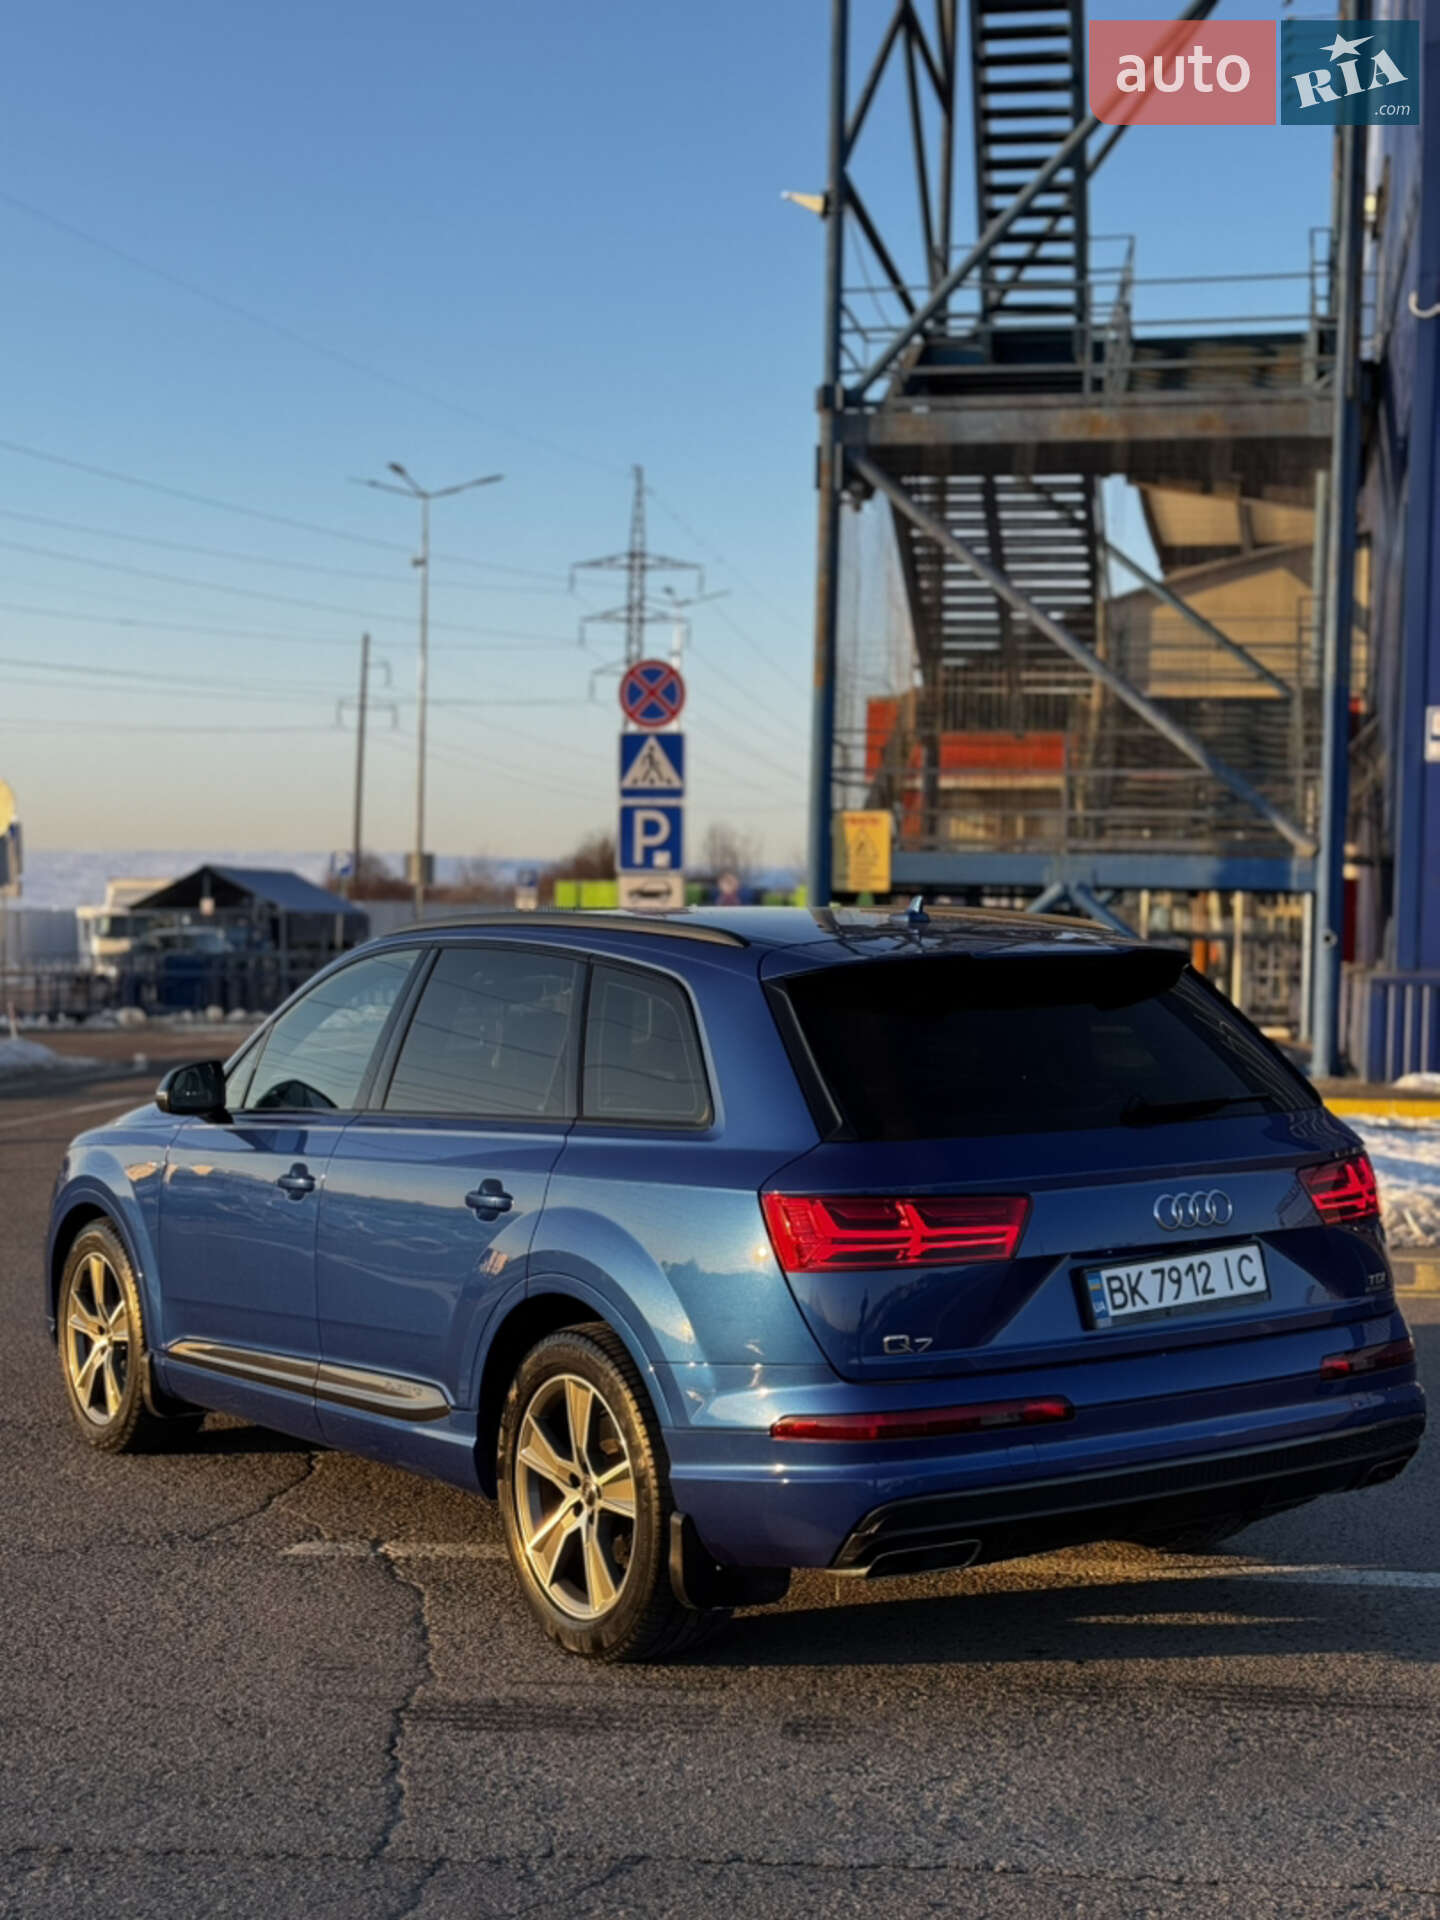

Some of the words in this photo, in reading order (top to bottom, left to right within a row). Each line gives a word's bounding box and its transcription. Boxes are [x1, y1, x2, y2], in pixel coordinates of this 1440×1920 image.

[633, 809, 671, 866] P
[1106, 1270, 1149, 1311] BK
[1151, 1261, 1216, 1303] 7912
[1224, 1254, 1257, 1291] IC
[883, 1335, 933, 1354] Q7
